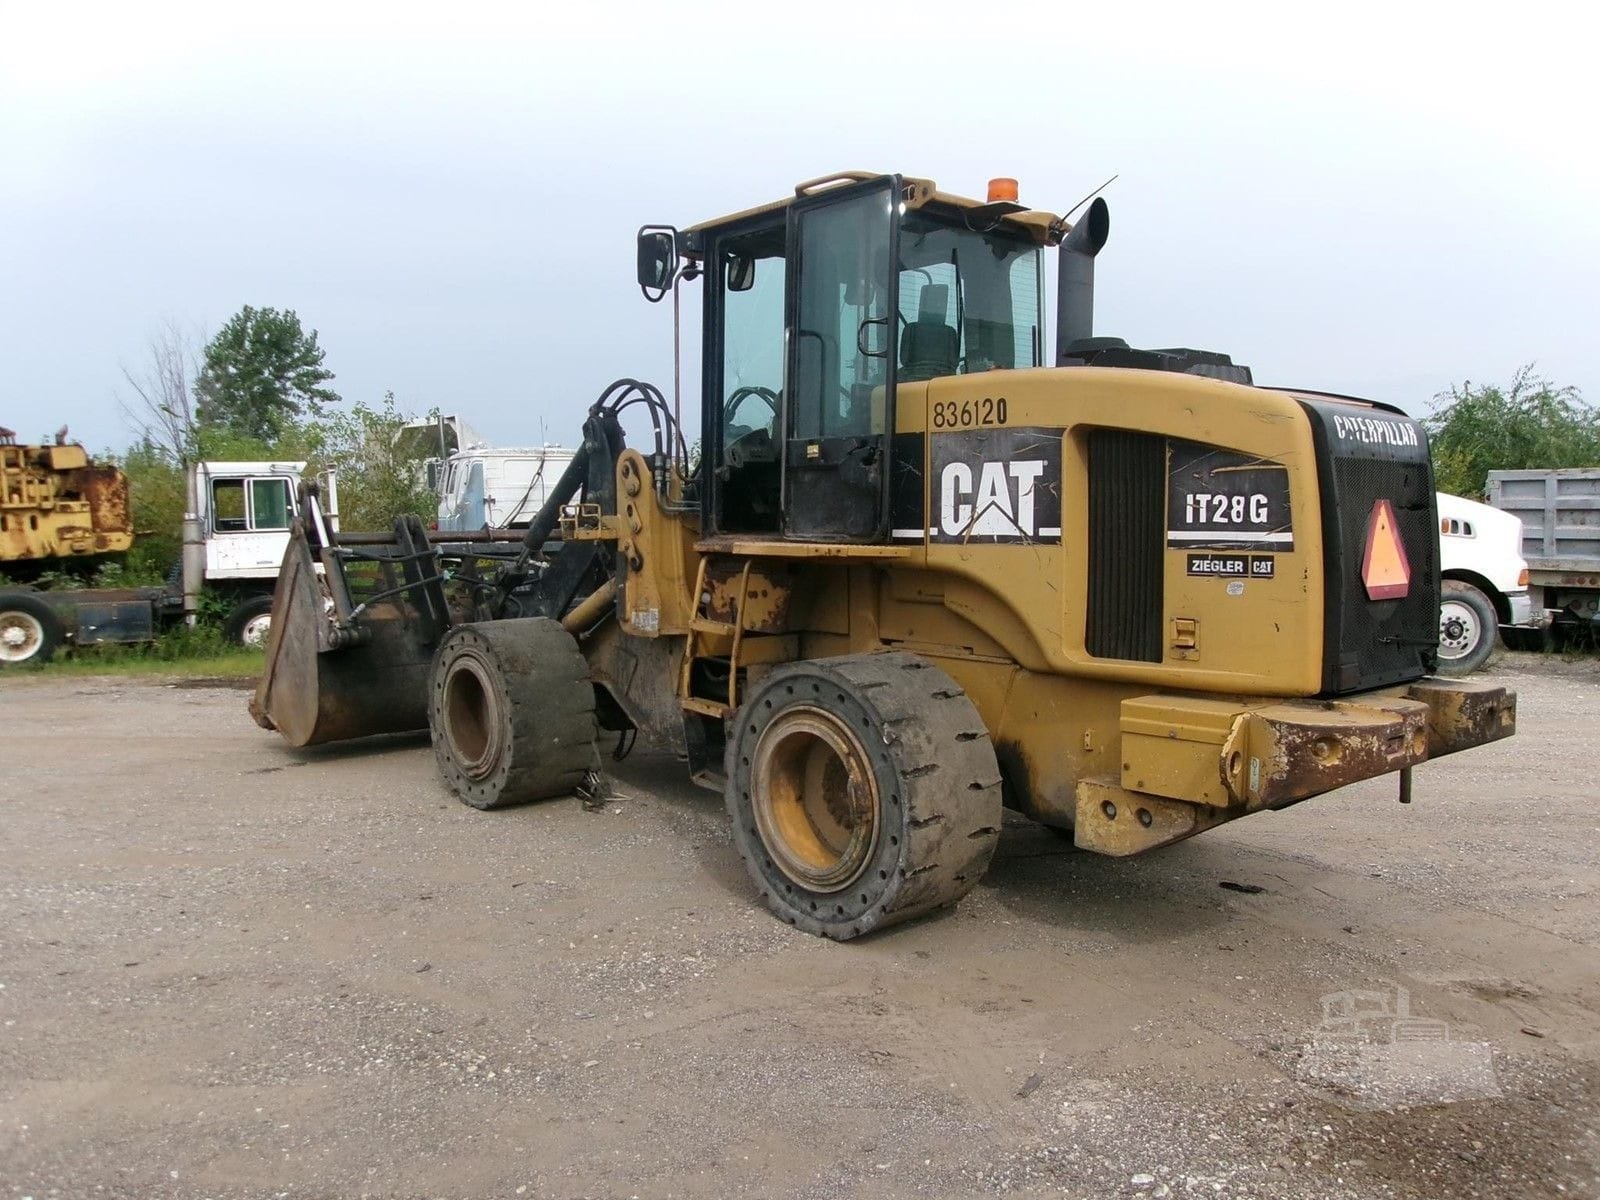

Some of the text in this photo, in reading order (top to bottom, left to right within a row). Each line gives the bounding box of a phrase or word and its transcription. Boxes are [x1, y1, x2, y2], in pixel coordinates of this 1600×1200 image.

[934, 398, 1007, 428] 836120
[1333, 415, 1418, 446] CATERPILLAR
[941, 460, 1044, 536] CAT
[1186, 493, 1268, 523] IT28G
[1192, 560, 1272, 573] ZIEGLER CAT
